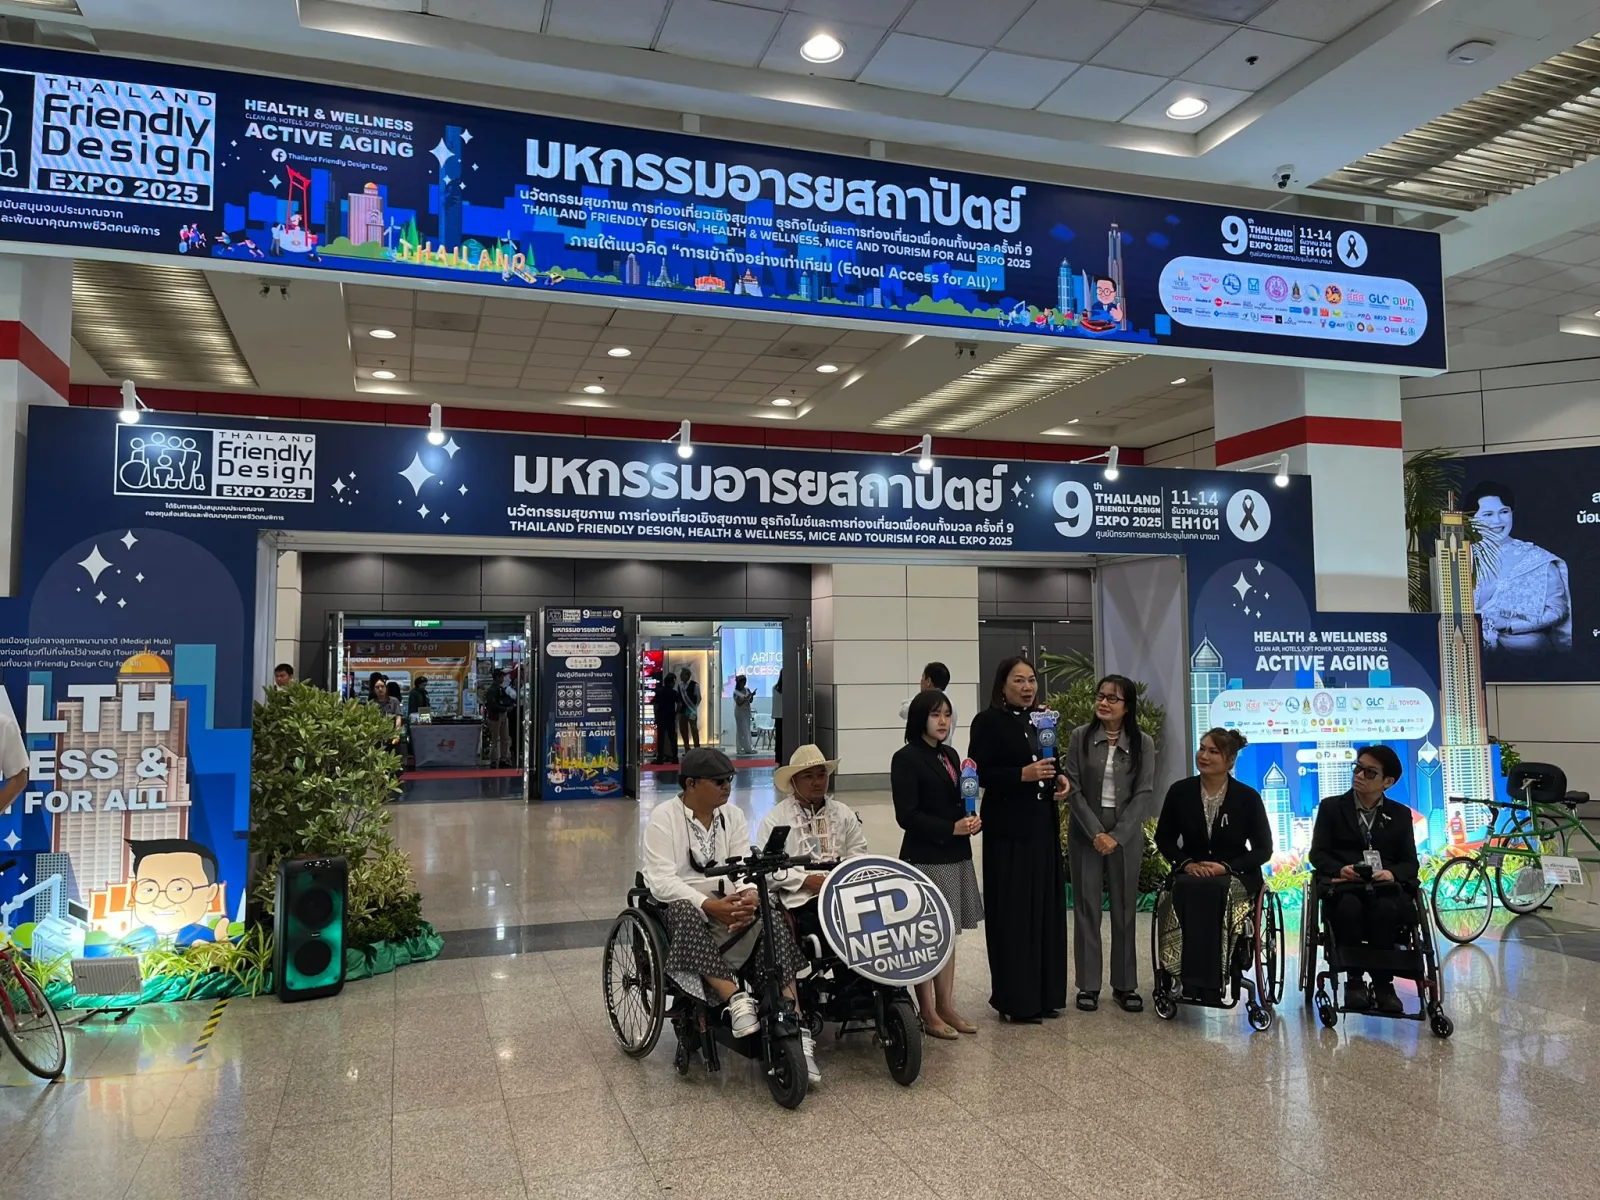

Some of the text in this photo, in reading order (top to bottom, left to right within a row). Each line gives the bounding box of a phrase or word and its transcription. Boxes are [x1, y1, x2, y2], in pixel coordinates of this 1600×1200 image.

[45, 77, 212, 106] THAILAND
[43, 94, 211, 146] Friendly
[245, 99, 413, 132] HEALTH & WELLNESS
[245, 113, 266, 121] CLEAN
[245, 122, 413, 158] ACTIVE AGING
[41, 125, 210, 176] Design
[287, 152, 388, 172] Thailand Friendly Design Expo
[50, 172, 199, 203] EXPO 2025
[526, 138, 1027, 233] มหกรรมอารยสถาปัตย์
[520, 187, 628, 210] นวัตกรรมสุขภาพ
[632, 201, 773, 227] การท่องเที่ยวเชิงสุขภาพ
[993, 239, 1022, 255] ครั้งที่
[1025, 245, 1033, 256] 9
[1249, 225, 1293, 238] THAILAND
[522, 204, 1031, 269] THAILAND FRIENDLY DESIGN, HEALTH & WELLNESS, MICE AND TOURISM FOR ALL EXPO 2025
[1220, 215, 1249, 256] 9
[1299, 227, 1332, 241] 11-14
[1249, 241, 1294, 253] EXPO 2025
[1300, 245, 1333, 258] EH101
[570, 233, 667, 256] ภายใต้แนวคิด
[837, 260, 885, 278] (Equal
[888, 266, 939, 283] Access
[942, 272, 963, 286] for
[218, 431, 314, 443] THAILAND
[218, 441, 312, 466] Friendly
[218, 459, 313, 484] Design
[222, 484, 307, 499] EXPO 2025
[514, 455, 1008, 512] มหกรรมอารยสถาปัตย์
[1095, 493, 1161, 506] THAILAND
[1171, 489, 1219, 506] 11-14
[507, 504, 615, 522] นวัตกรรมสุขภาพ
[619, 507, 757, 528] การท่องเที่ยวเชิงสุขภาพ
[975, 518, 1004, 533] ครั้งที่
[1006, 523, 1015, 533] 9
[1052, 480, 1102, 538] 9 th
[1095, 505, 1161, 514] FRIENDLY DESIGN
[1171, 506, 1219, 516] ธันวาคม 2568
[1095, 515, 1161, 528] EXPO 2025
[1171, 516, 1220, 531] EH101
[509, 521, 1013, 546] THAILAND FRIENDLY DESIGN, HEALTH & WELLNESS, MICE AND TOURISM FOR ALL EXPO 2025
[1200, 533, 1220, 541] บางนา
[582, 609, 590, 619] 9
[120, 637, 172, 646] (Medical Hub)
[380, 643, 395, 651] Eat
[412, 643, 438, 651] Treat
[1254, 631, 1388, 643] HEALTH & WELLNESS
[34, 660, 69, 669] (Friendly
[70, 660, 97, 669] Design
[98, 660, 114, 669] City
[1255, 655, 1389, 671] ACTIVE AGING
[555, 730, 587, 738] ACTIVE
[0, 747, 169, 781] ESS &
[965, 781, 975, 789] FD
[24, 790, 93, 815] FOR
[103, 788, 167, 812] ALL
[839, 877, 922, 933] FD
[849, 920, 939, 962] NEWS
[874, 946, 939, 974] ONLINE
